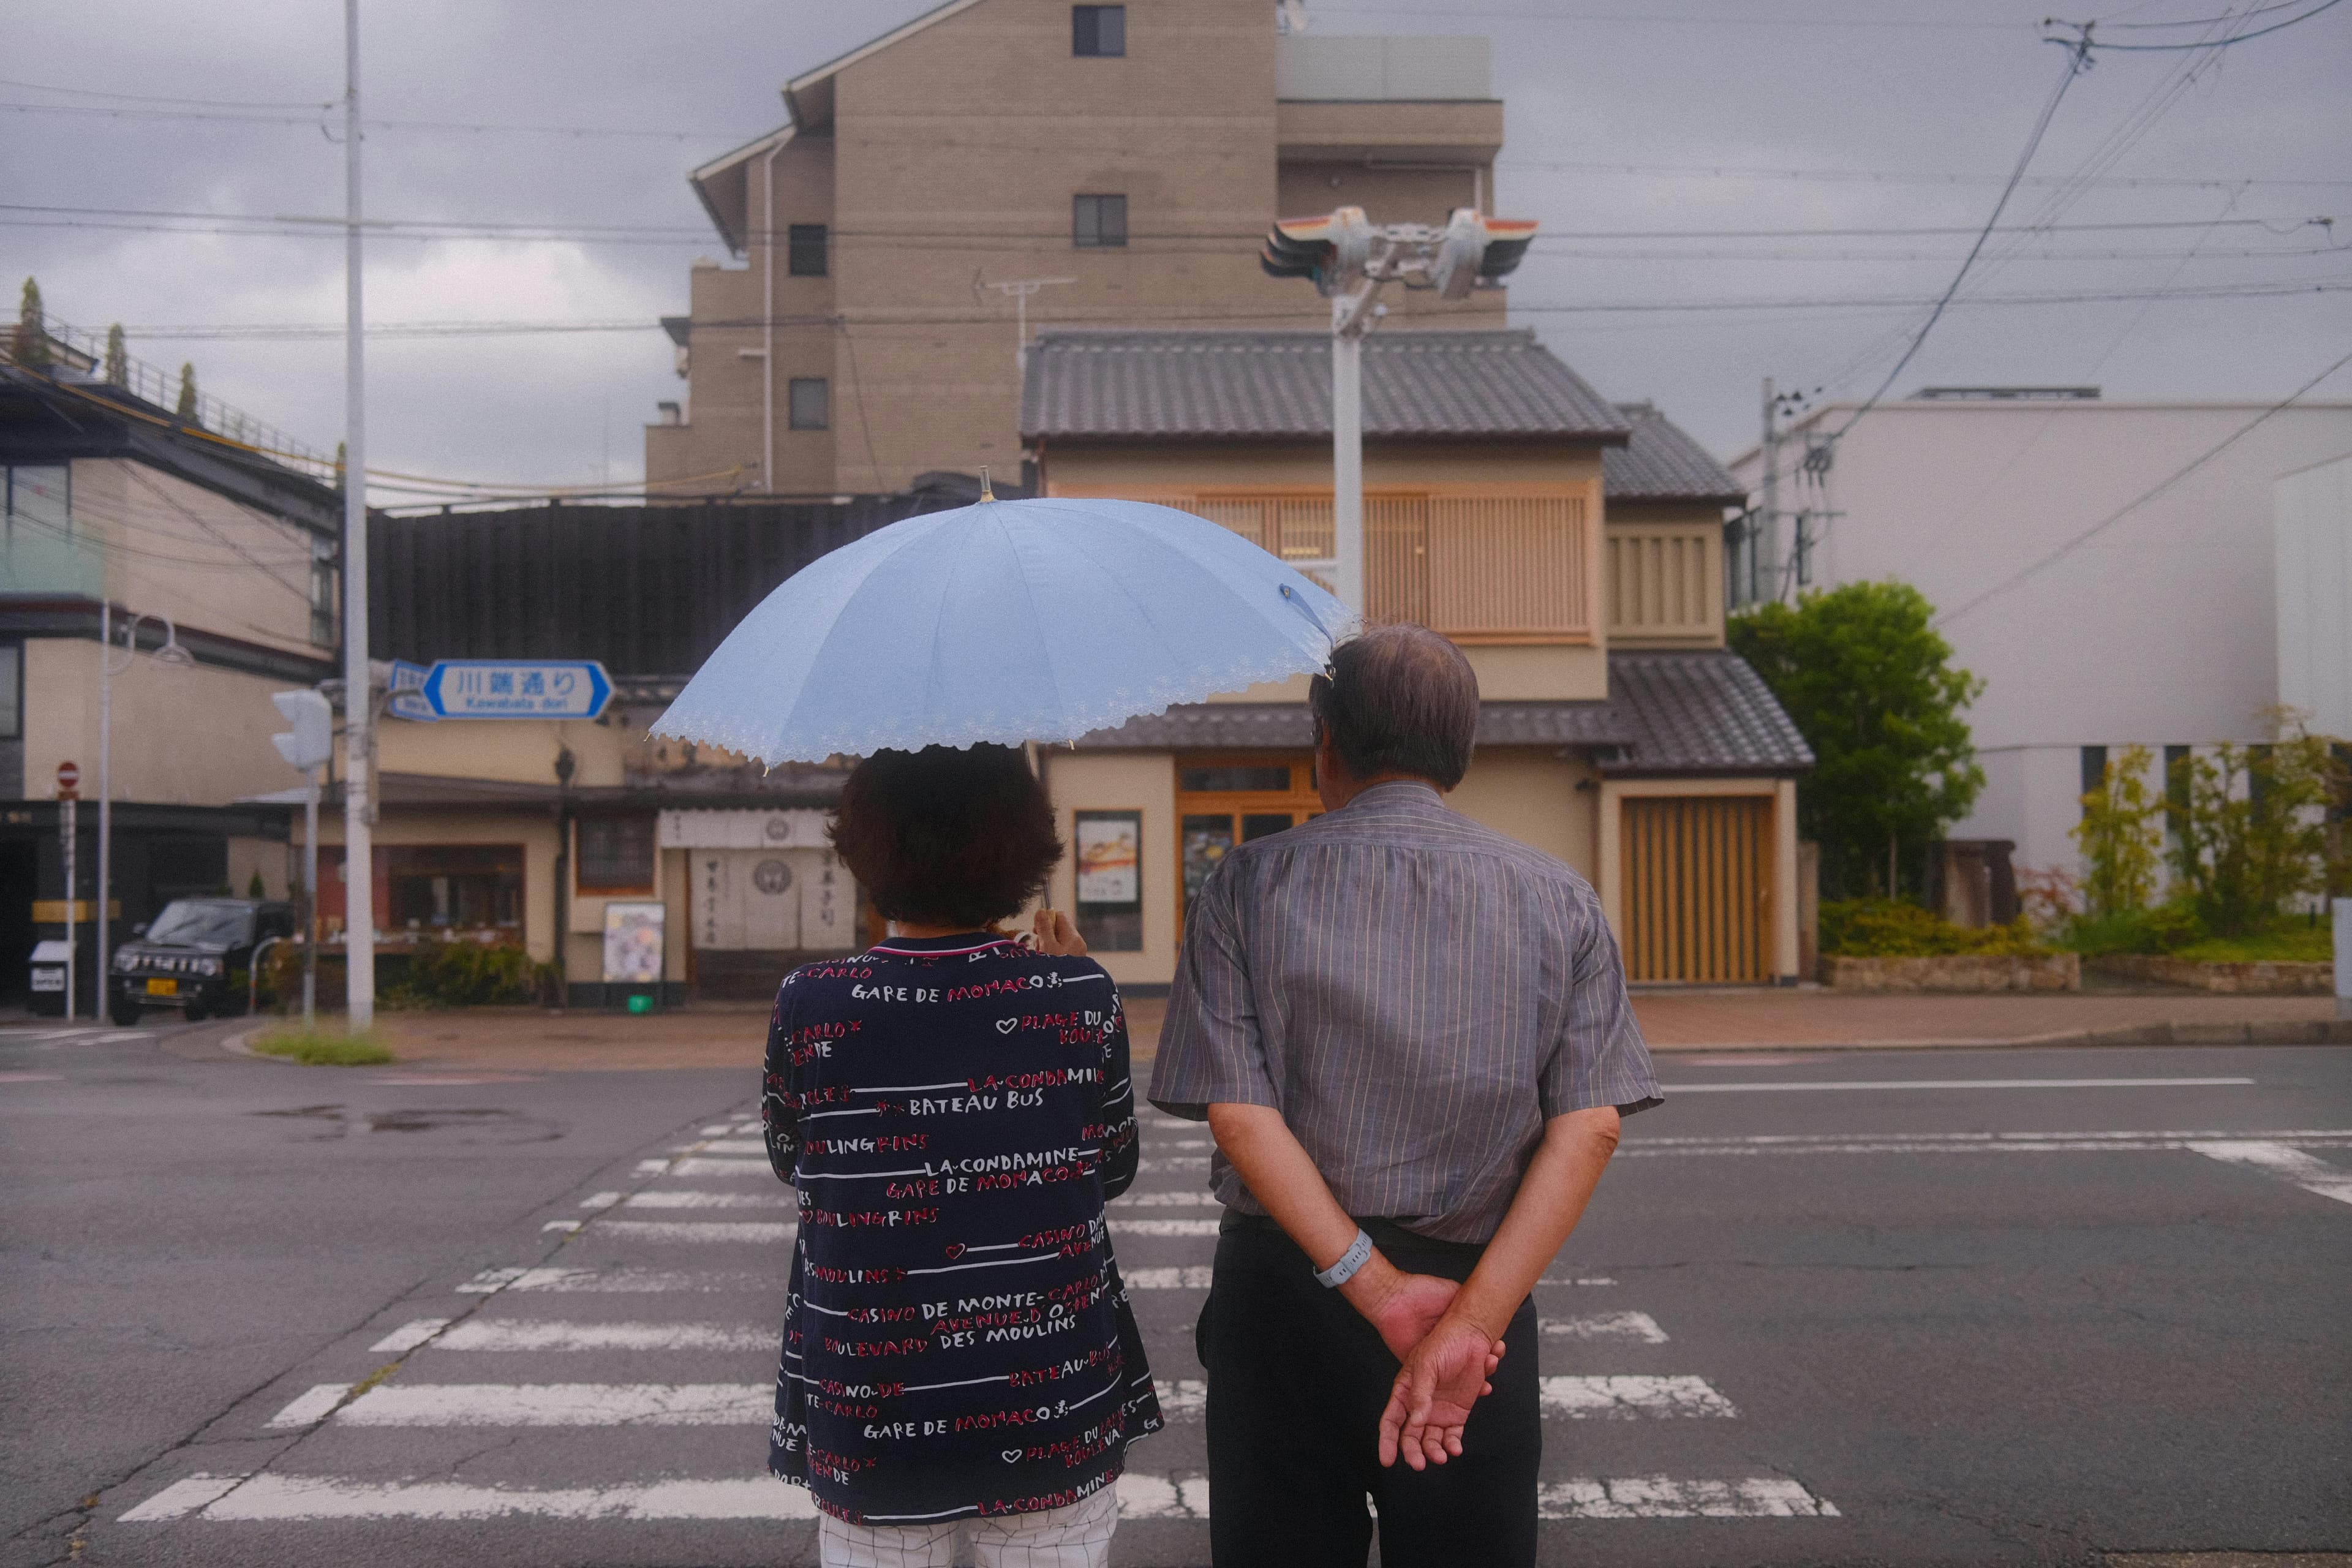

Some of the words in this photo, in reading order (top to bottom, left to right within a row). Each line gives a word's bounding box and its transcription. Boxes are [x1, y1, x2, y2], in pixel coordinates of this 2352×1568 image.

[915, 988, 940, 1003] DE
[946, 975, 1044, 1003] MONACO
[1084, 1010, 1101, 1026] DU
[910, 1095, 997, 1115] BATEAU
[1007, 1087, 1043, 1109] BUS
[946, 1177, 970, 1194] DE
[976, 1166, 1069, 1191] MONACO
[1018, 1224, 1085, 1248] CASINO
[848, 1306, 915, 1324] CASINO
[922, 1302, 948, 1319] DE
[940, 1330, 976, 1349] DES
[986, 1314, 1076, 1342] MOULINS
[924, 1420, 948, 1436] DE
[955, 1406, 1050, 1432] MONACO
